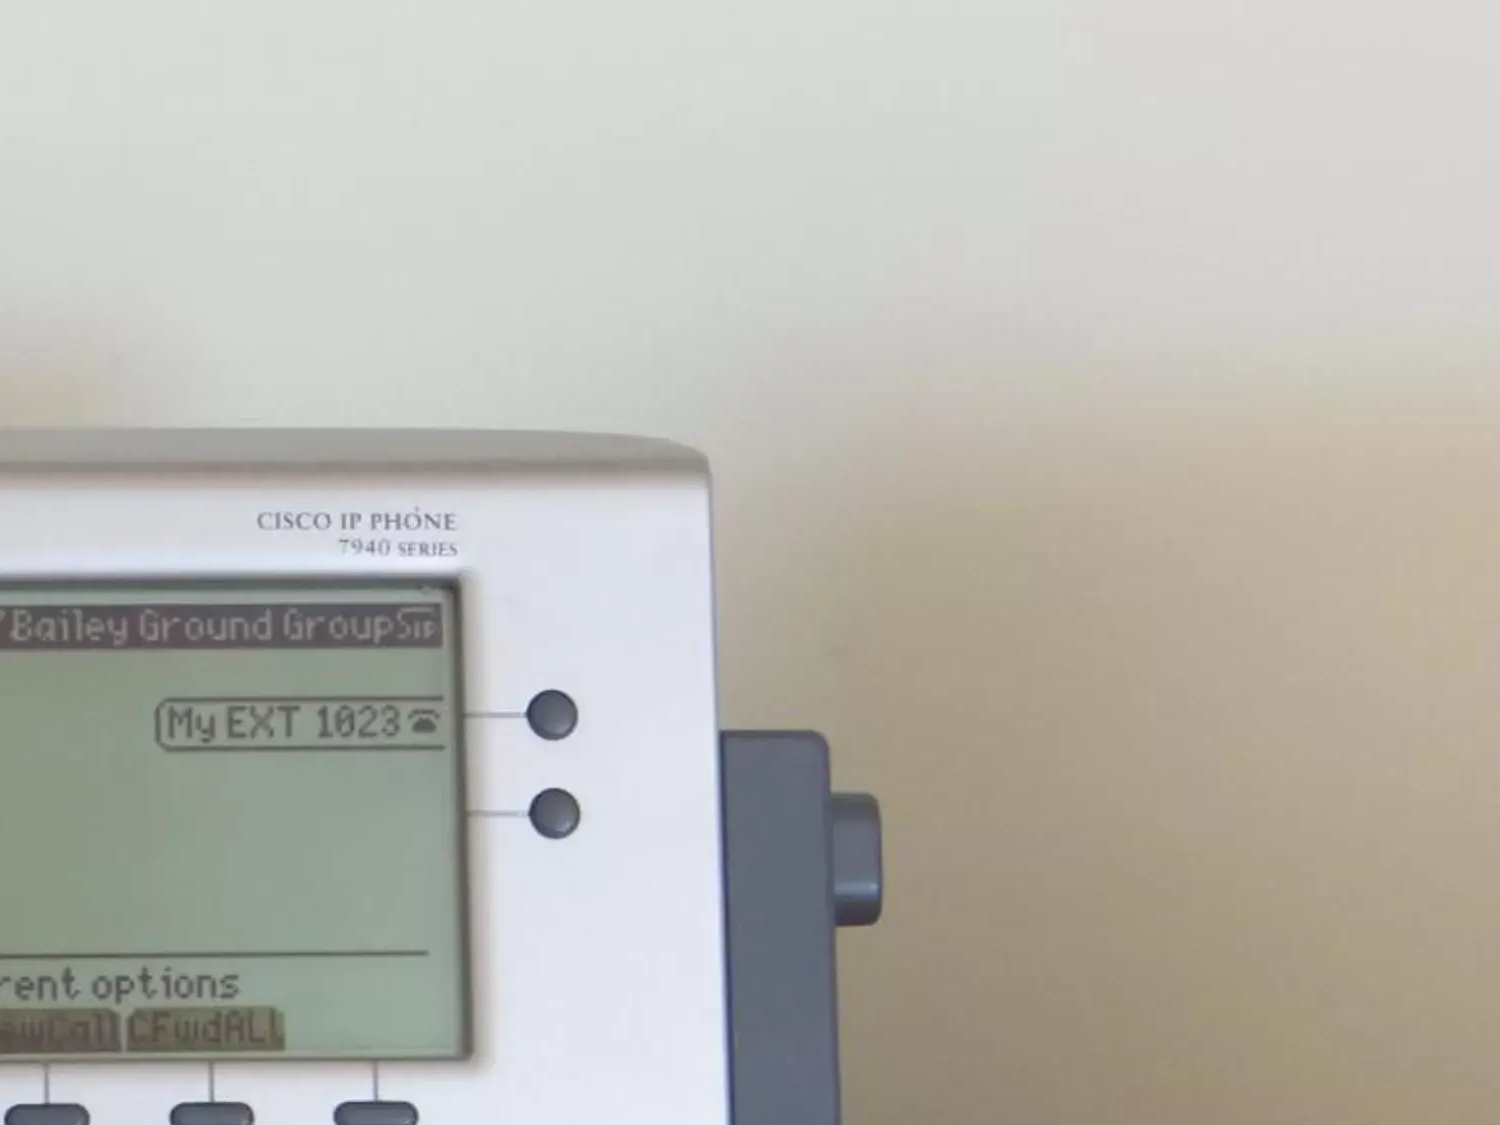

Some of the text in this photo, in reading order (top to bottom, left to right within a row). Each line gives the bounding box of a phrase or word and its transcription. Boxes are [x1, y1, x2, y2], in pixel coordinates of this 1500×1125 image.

[257, 511, 460, 531] CISCO IP PHONE
[338, 537, 458, 557] 7940 SERIES
[9, 608, 129, 647] Bailey
[139, 609, 273, 643] Ground
[283, 608, 393, 644] Group
[166, 704, 400, 744] My EXT 1023
[91, 966, 240, 1005] options
